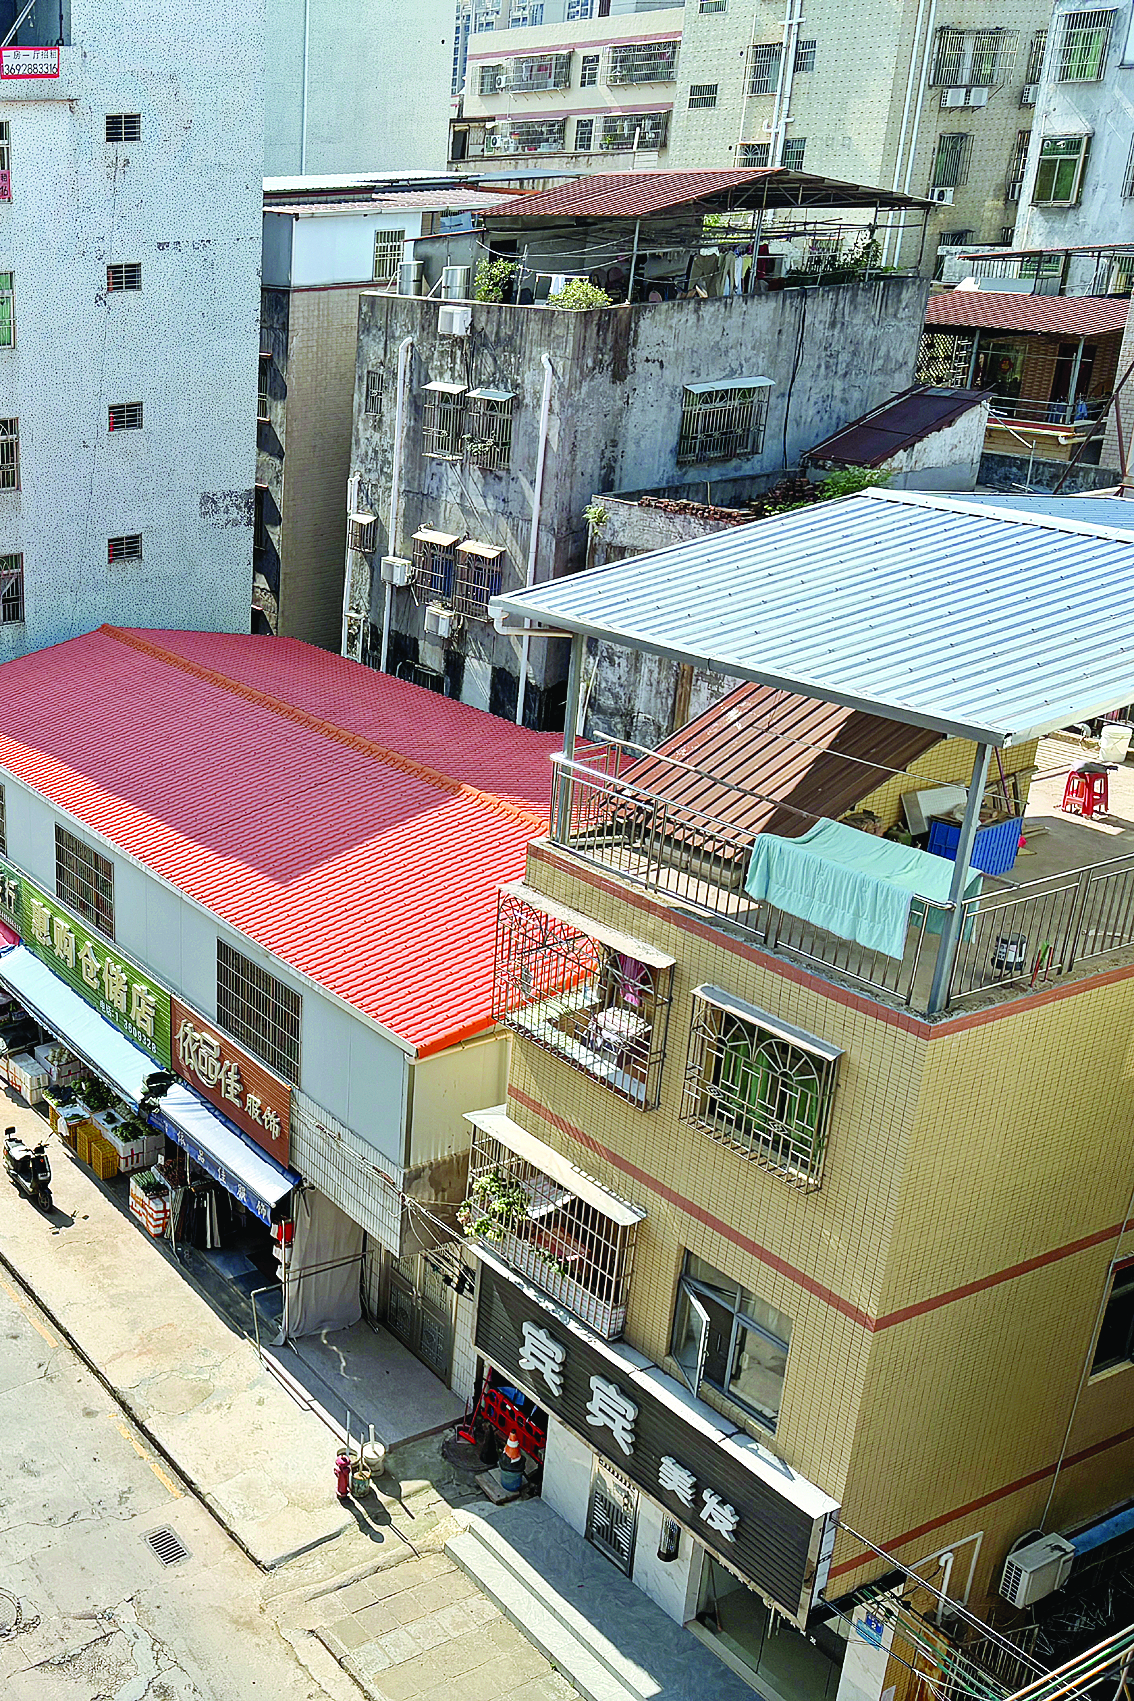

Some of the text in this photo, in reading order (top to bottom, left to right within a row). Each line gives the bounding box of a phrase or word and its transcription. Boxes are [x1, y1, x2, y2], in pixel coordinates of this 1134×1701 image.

[4, 50, 56, 59] 一房一厅招租
[30, 898, 156, 1038] 惠购仓储店
